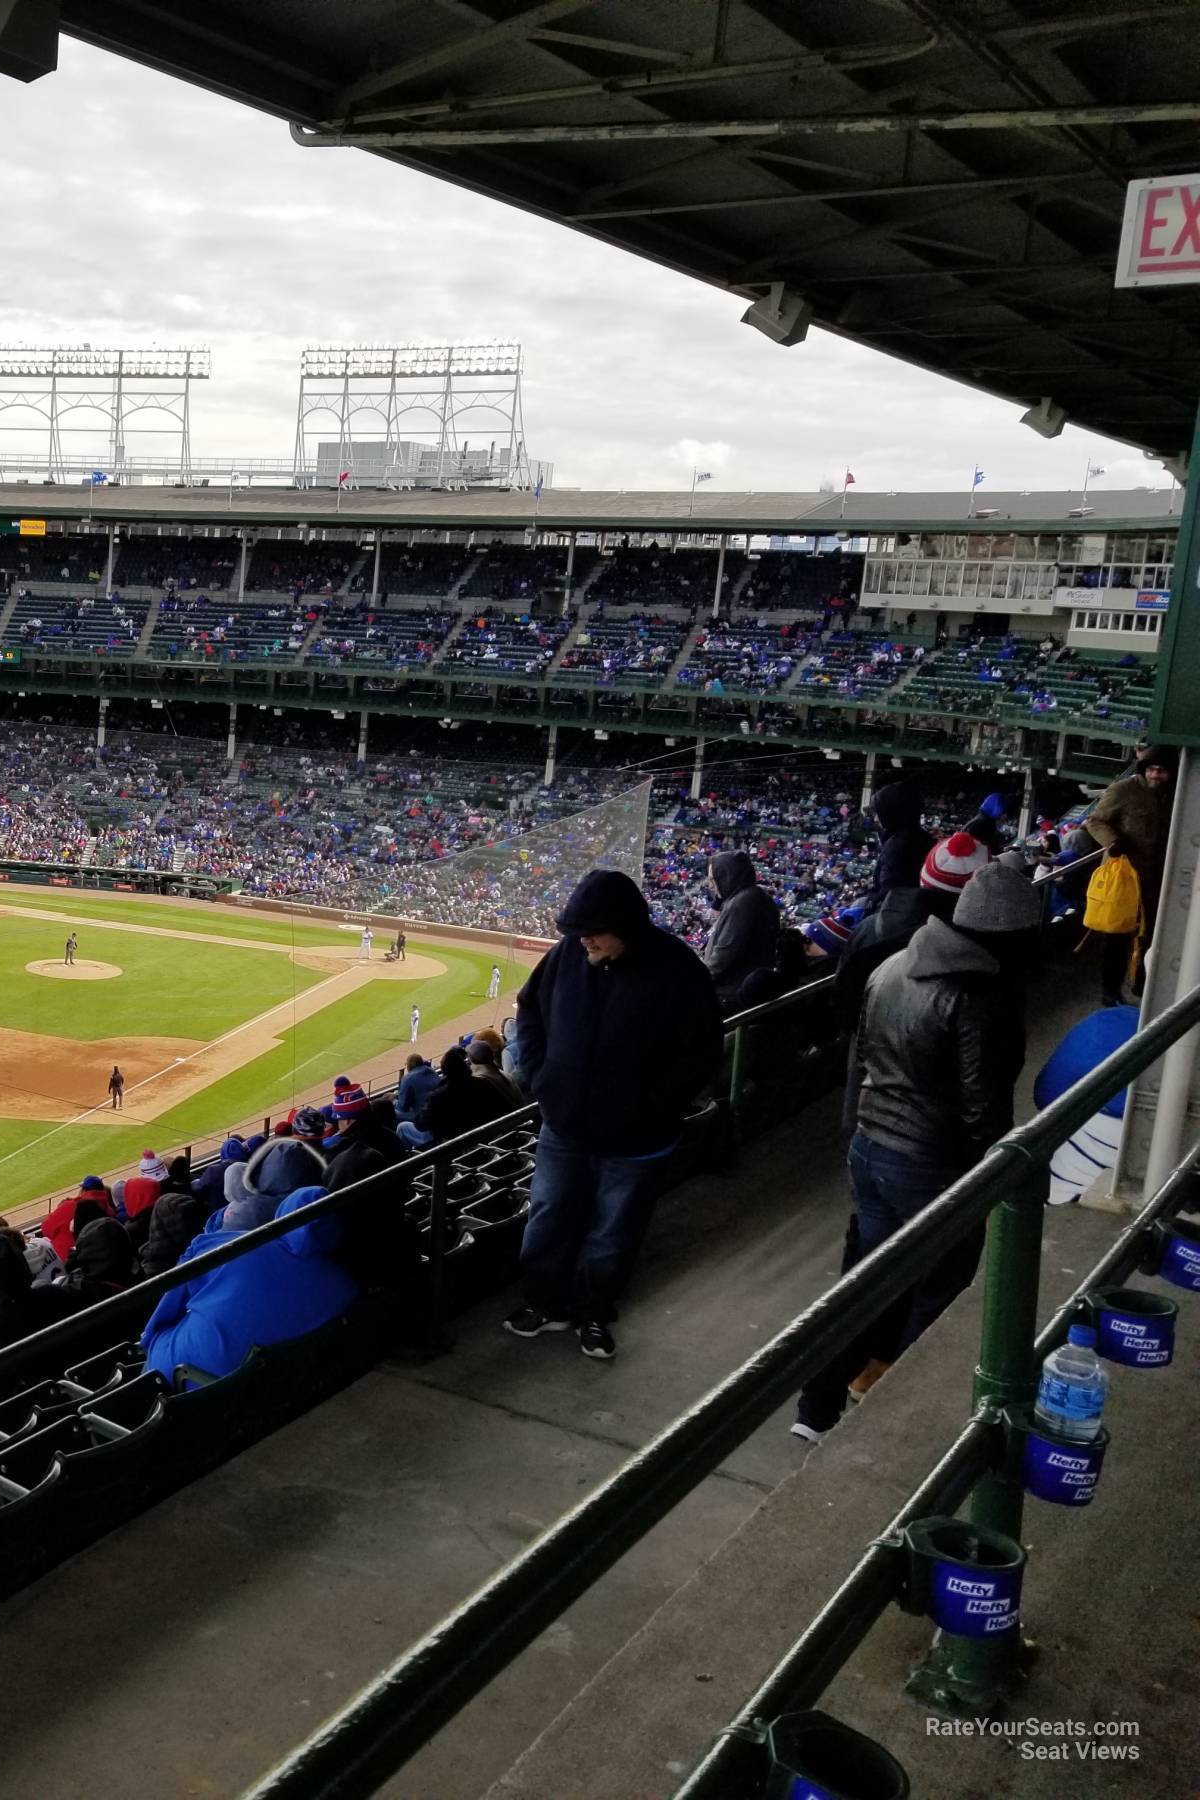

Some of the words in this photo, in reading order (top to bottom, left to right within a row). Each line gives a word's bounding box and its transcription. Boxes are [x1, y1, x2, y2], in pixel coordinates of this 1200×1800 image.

[1112, 1321, 1144, 1336] Hefty
[1126, 1338, 1158, 1349] Hefty
[1050, 1454, 1087, 1470] Hefty
[950, 1579, 991, 1596] Hefty
[969, 1601, 1009, 1612] Hefty
